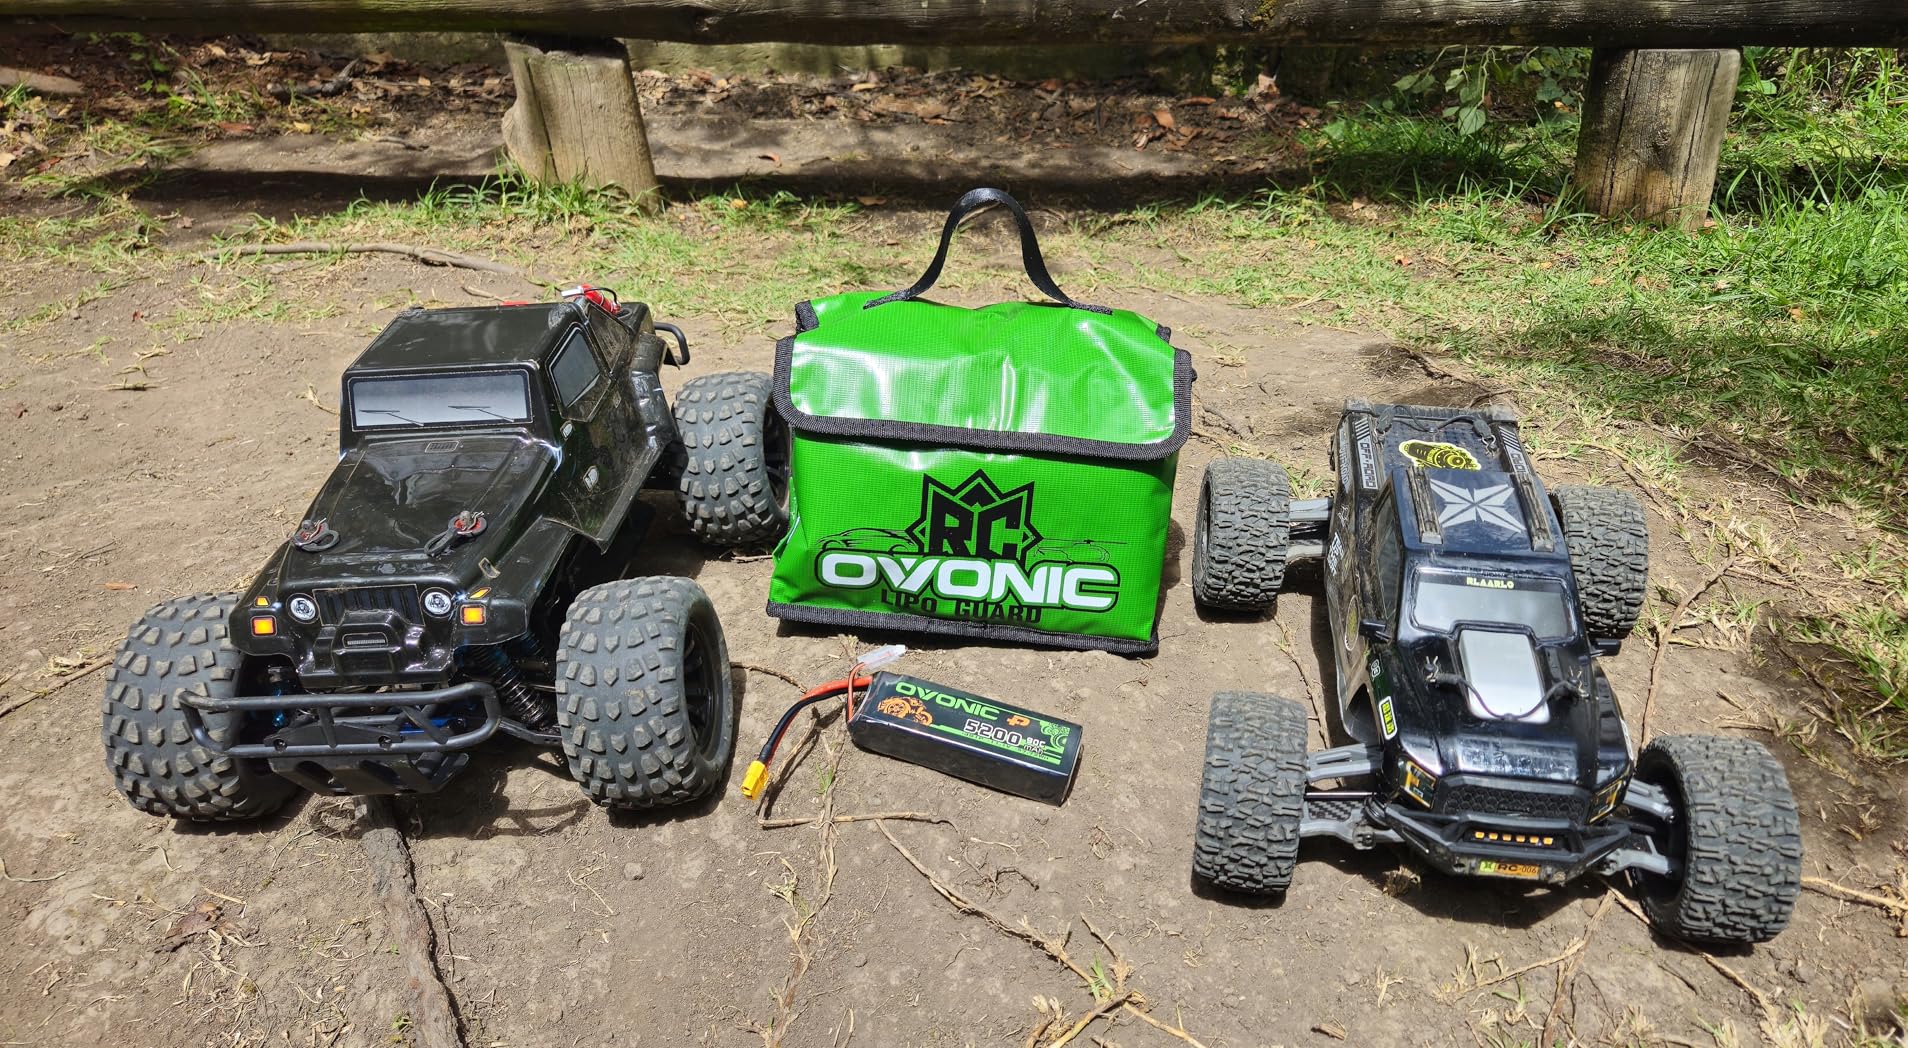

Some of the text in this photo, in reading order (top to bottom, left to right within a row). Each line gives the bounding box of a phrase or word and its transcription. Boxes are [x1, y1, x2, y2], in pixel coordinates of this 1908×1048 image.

[927, 488, 1025, 560] RC
[819, 550, 1121, 609] OVONIC
[1466, 576, 1515, 589] RLAARLO
[880, 588, 1043, 625] LIPO GUARD
[895, 681, 1000, 720] OVONIC
[963, 718, 1022, 747] 5200
